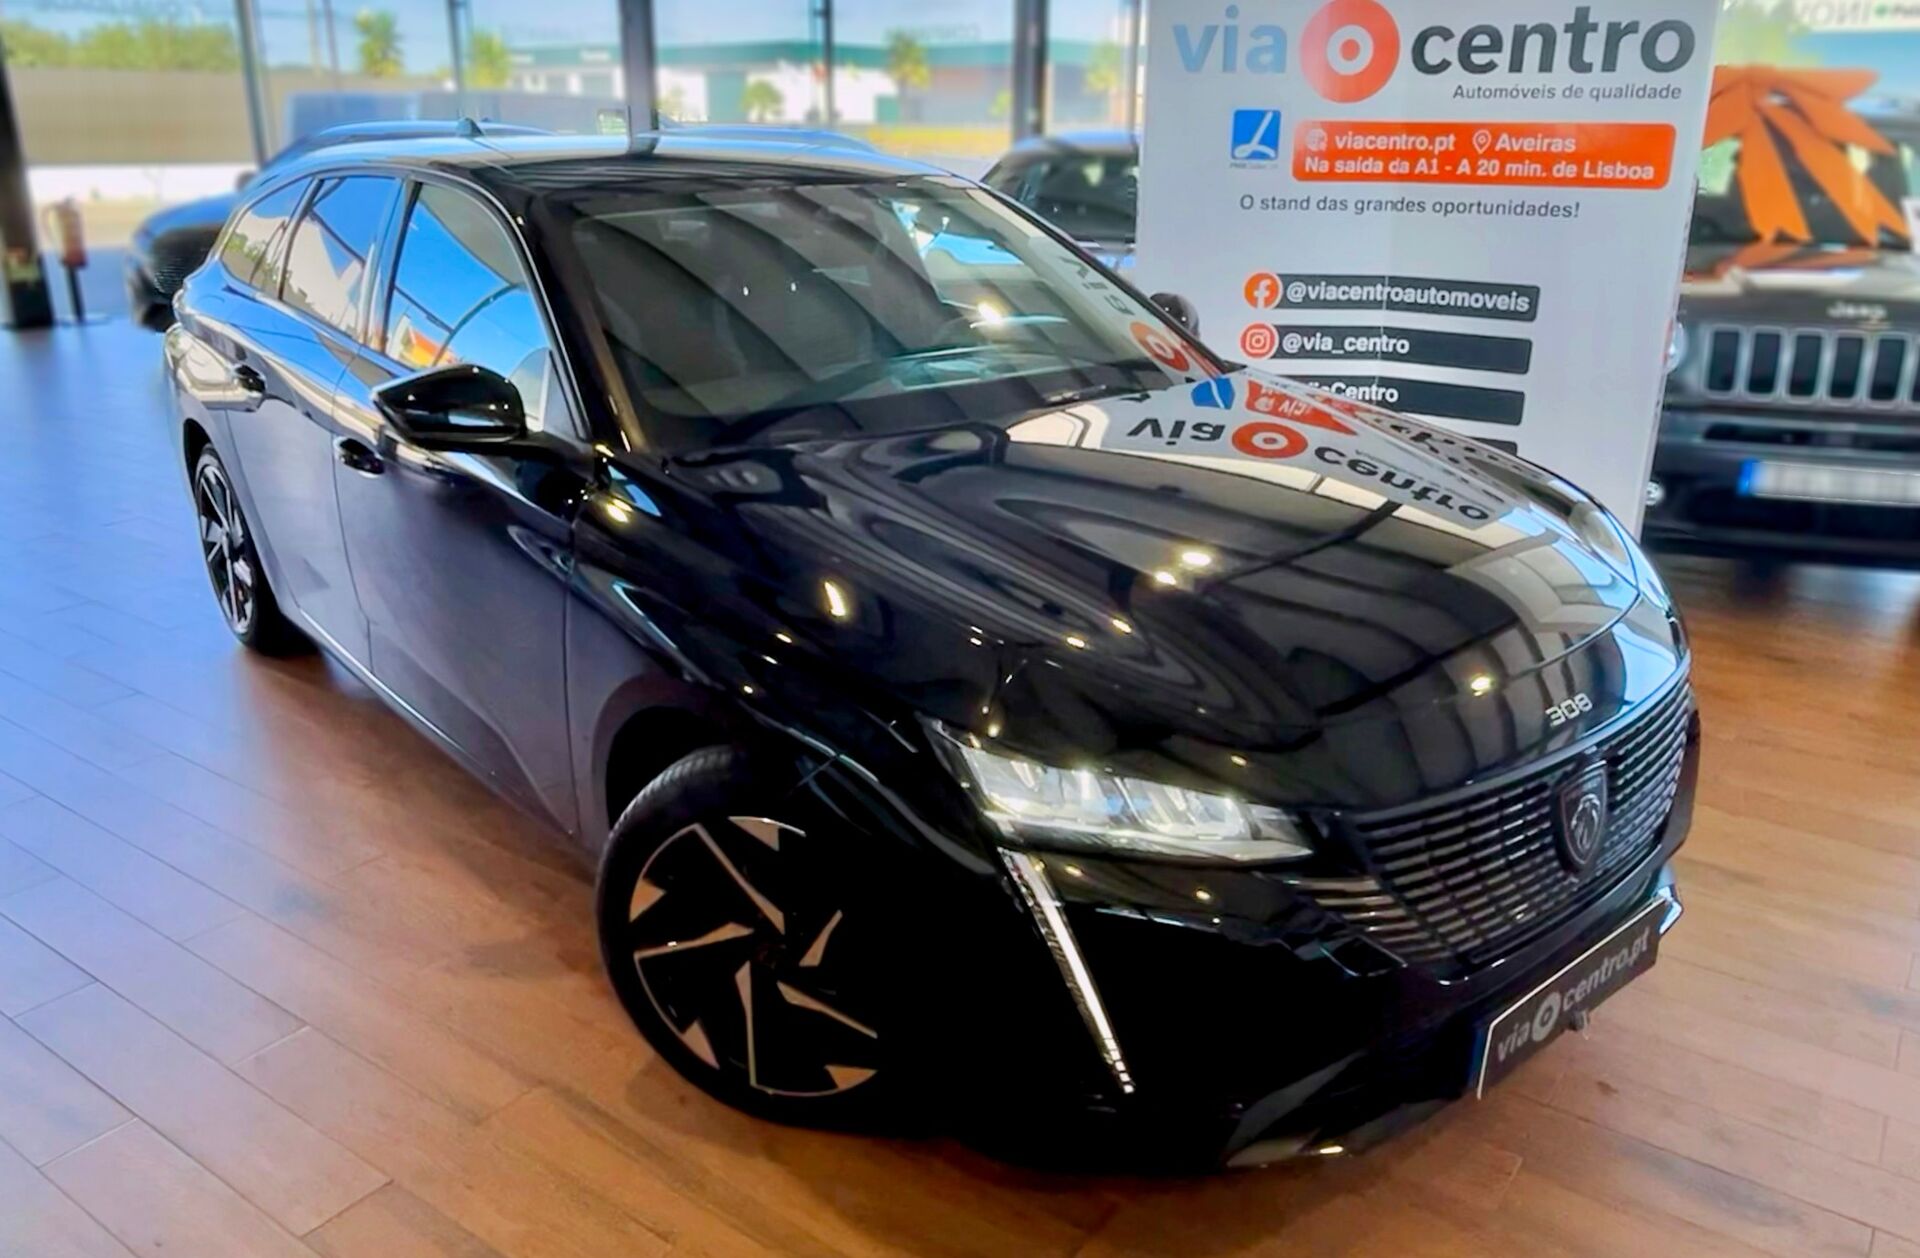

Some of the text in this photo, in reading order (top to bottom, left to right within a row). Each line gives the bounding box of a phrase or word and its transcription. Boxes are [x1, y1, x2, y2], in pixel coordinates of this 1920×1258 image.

[1172, 4, 1696, 75] via centro
[1453, 83, 1682, 101] Automóveis de qualidade
[1334, 131, 1577, 154] viacentro.pt Aveiras
[1304, 156, 1329, 173] Na
[1334, 156, 1384, 174] saída
[1388, 157, 1411, 174] da
[1414, 158, 1440, 175] A1
[1456, 158, 1472, 176] A
[1477, 159, 1500, 176] 20
[1504, 159, 1547, 177] min.
[1552, 160, 1578, 178] de
[1583, 161, 1656, 180] Lisboa
[1239, 194, 1581, 218] O stand das grandes oportunidades!
[1285, 281, 1531, 313] @viacentroautomoveis
[1282, 332, 1411, 355] @via_centro
[1545, 693, 1594, 727] 308
